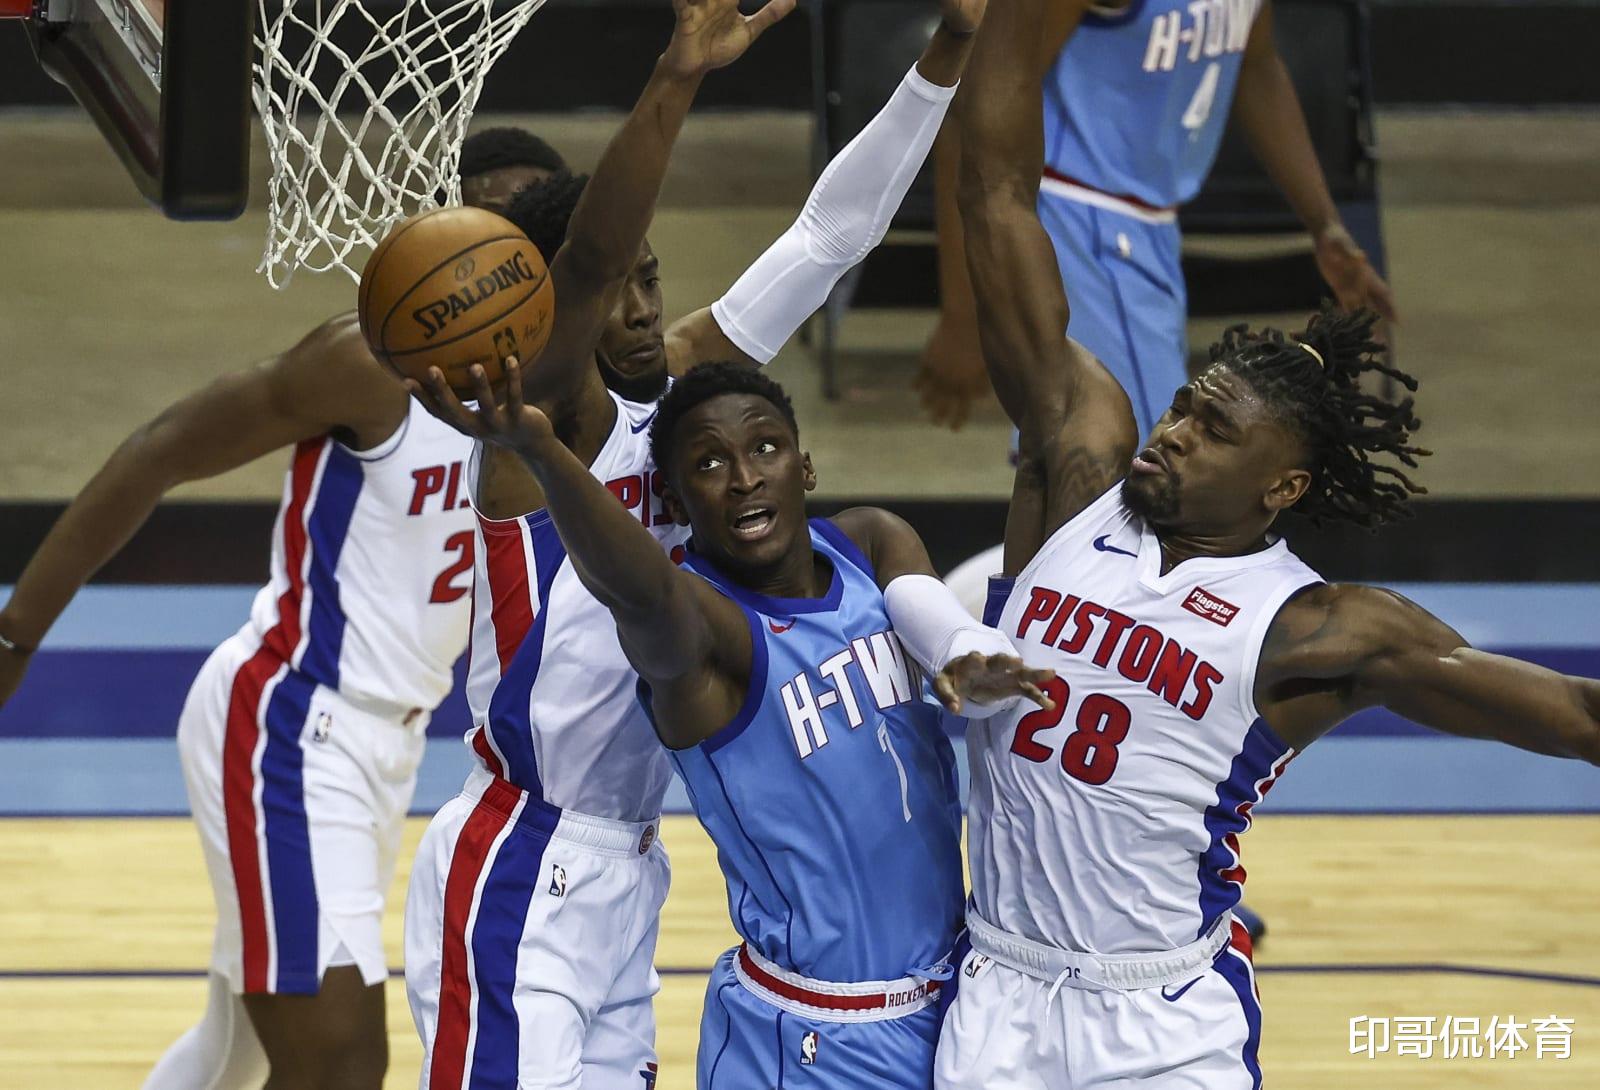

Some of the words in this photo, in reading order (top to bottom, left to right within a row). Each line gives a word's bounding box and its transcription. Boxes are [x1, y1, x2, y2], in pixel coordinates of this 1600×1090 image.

[1181, 62, 1221, 142] 4
[412, 250, 535, 340] SPALDING
[407, 461, 471, 516] PI
[1191, 590, 1235, 617] Flagstar
[1016, 586, 1225, 721] PISTONS
[1010, 675, 1132, 785] 28
[888, 983, 925, 1008] ROCKETS
